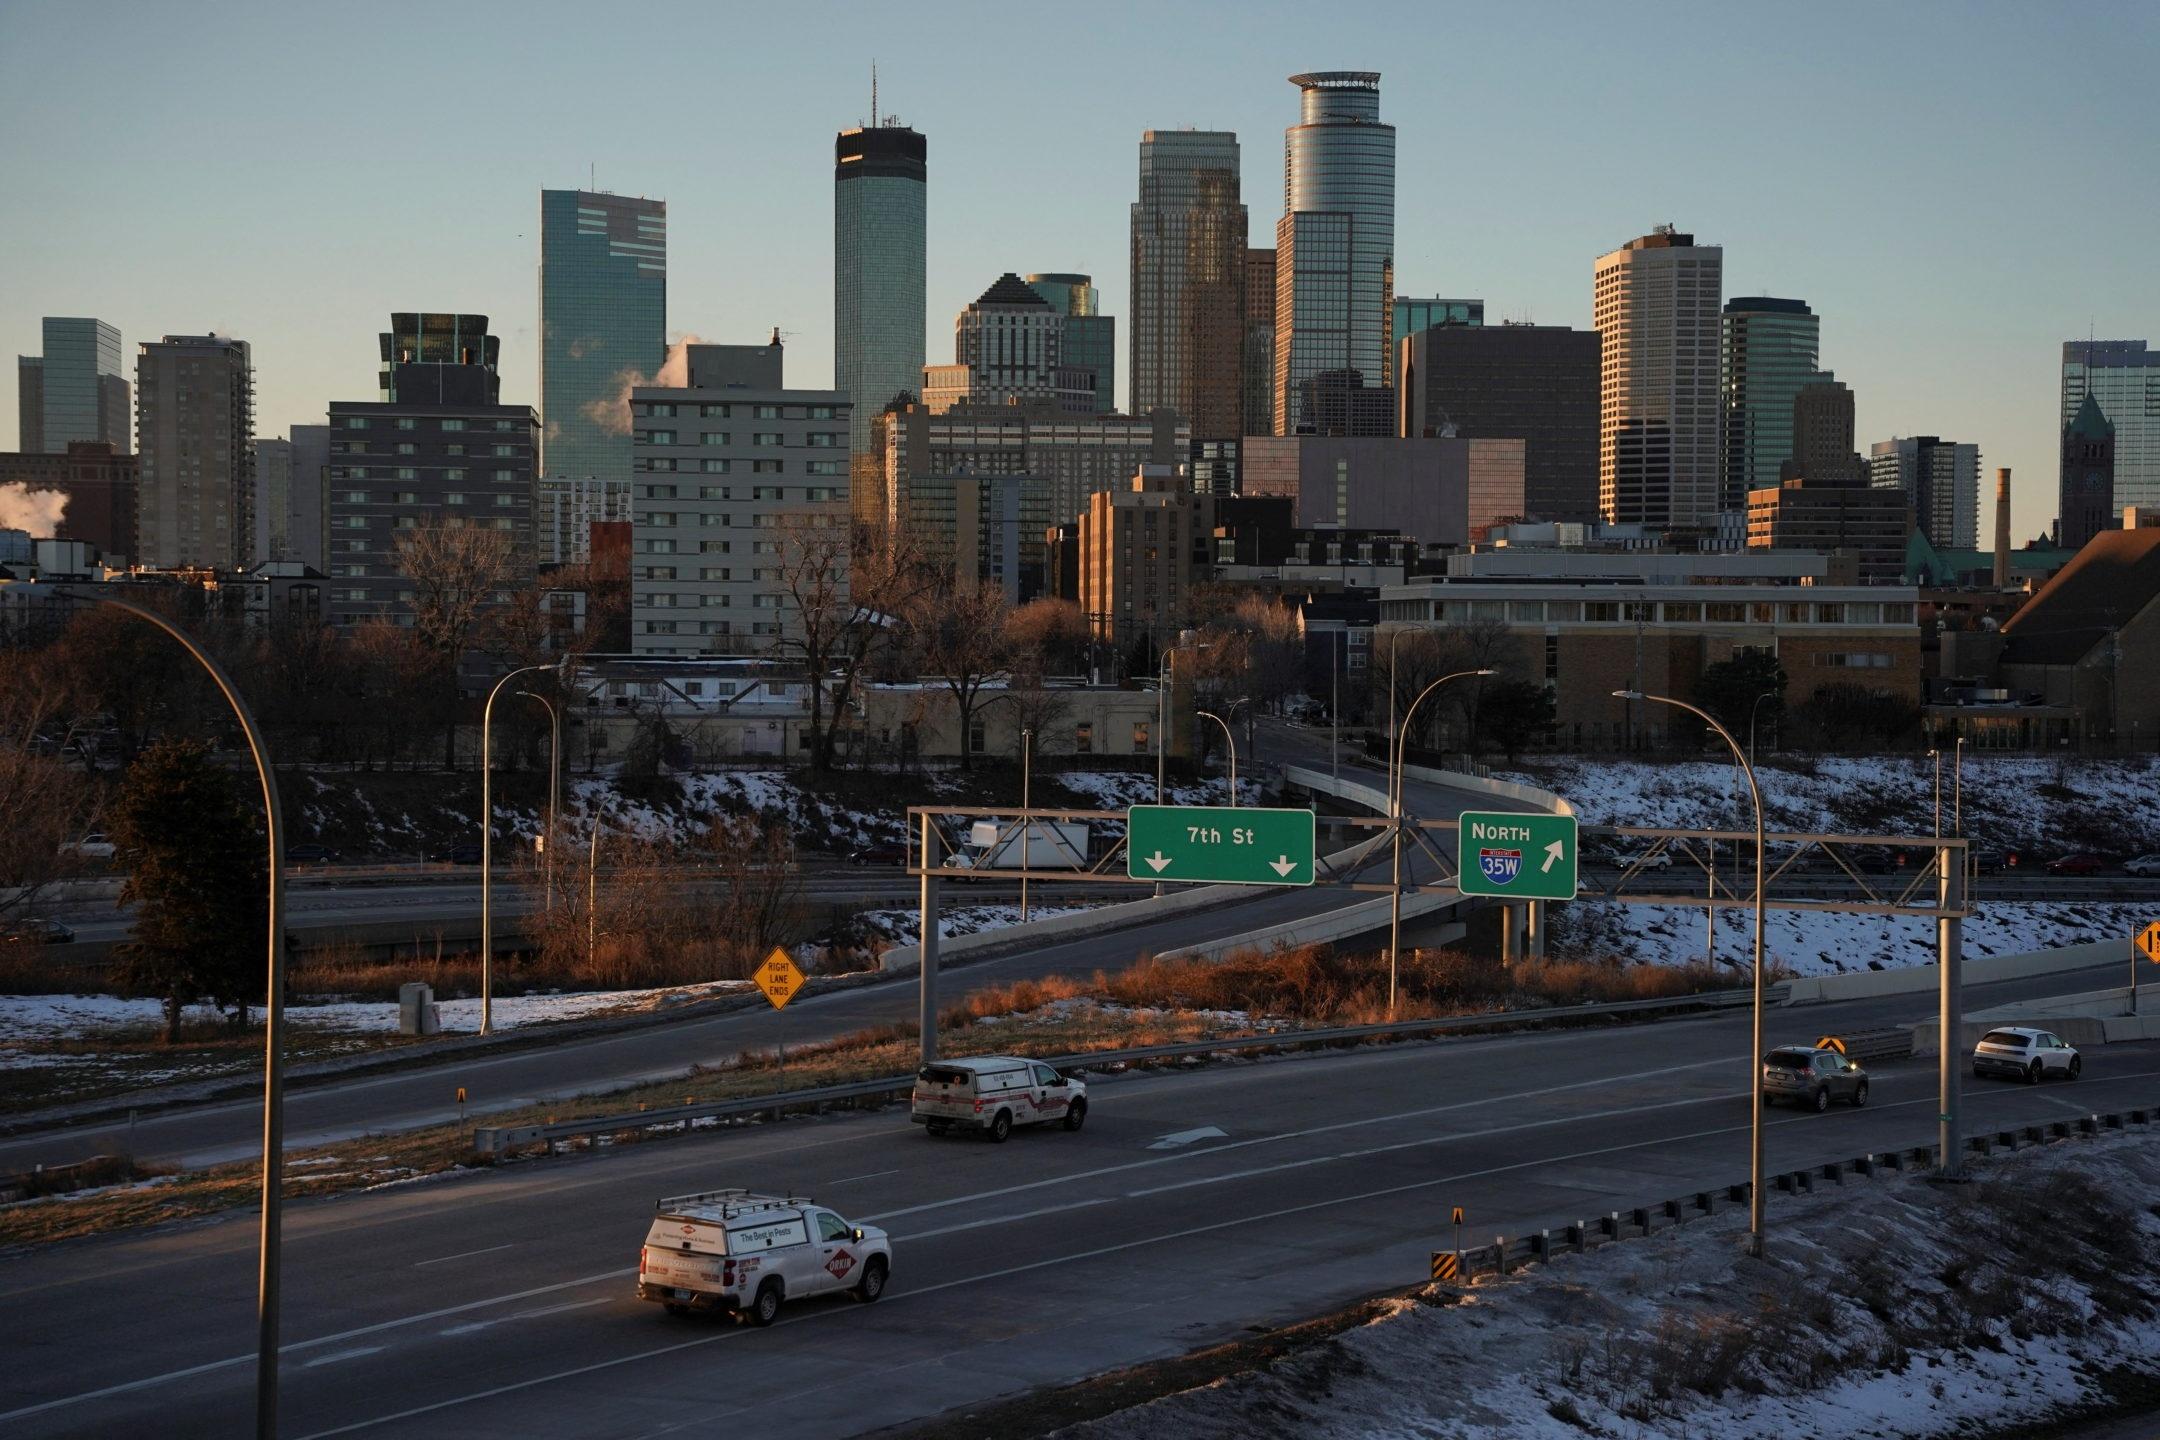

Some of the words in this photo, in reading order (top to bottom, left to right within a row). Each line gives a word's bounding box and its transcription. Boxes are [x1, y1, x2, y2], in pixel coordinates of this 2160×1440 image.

[1187, 827, 1221, 843] 7th
[1232, 828, 1254, 844] St
[1472, 822, 1530, 841] NORTH
[1483, 858, 1518, 875] 35W
[768, 962, 789, 971] RIGHT
[770, 975, 788, 983] LANE
[769, 987, 789, 995] ENDS
[740, 1233, 753, 1242] The
[753, 1231, 767, 1241] Best
[774, 1228, 791, 1236] Pests
